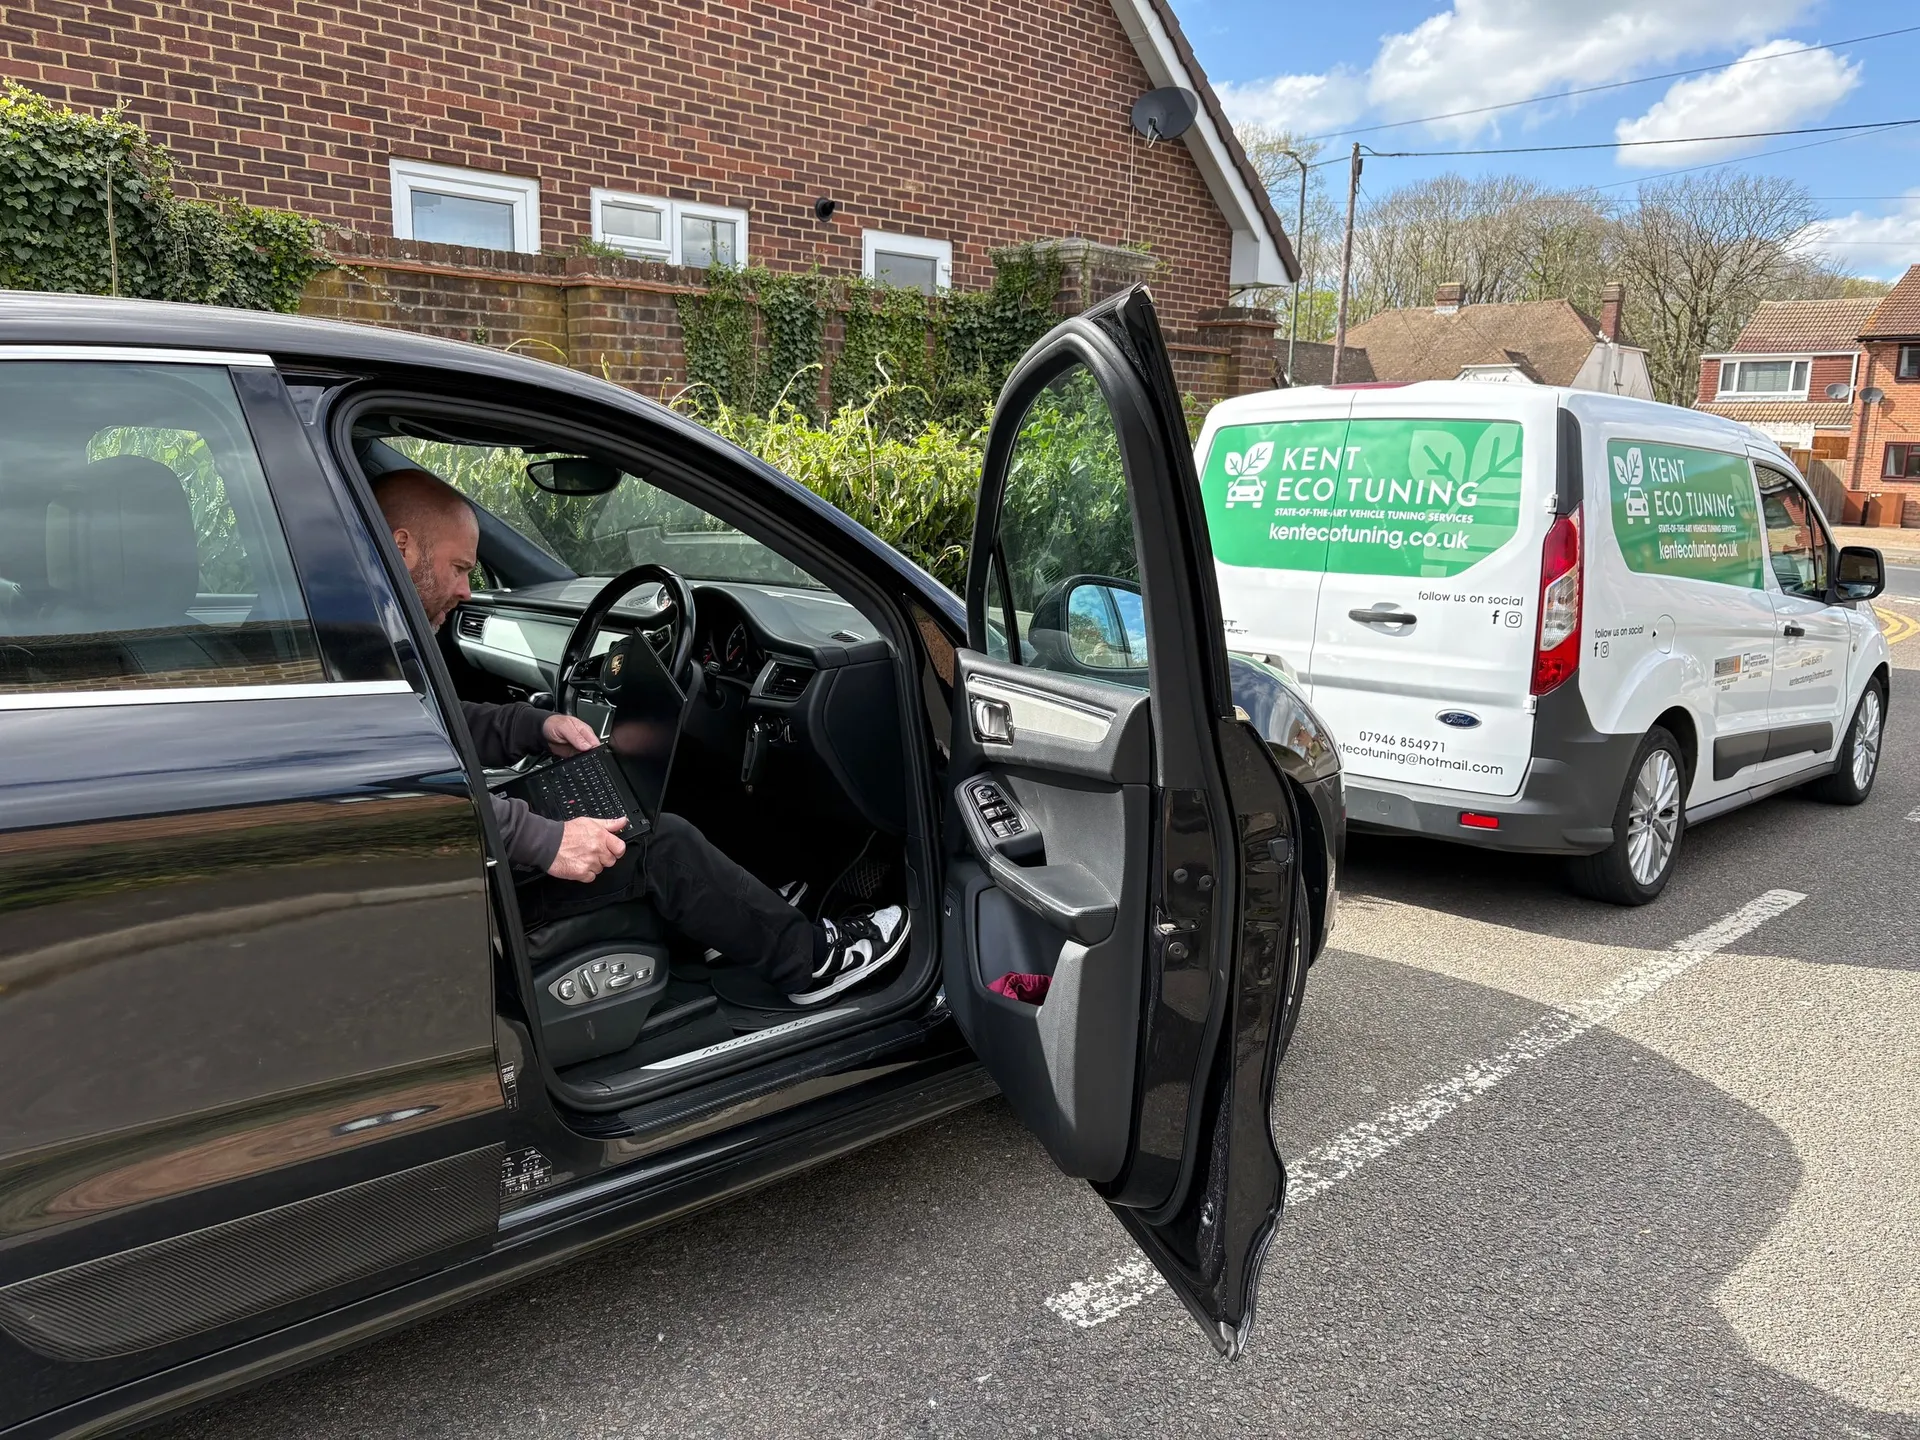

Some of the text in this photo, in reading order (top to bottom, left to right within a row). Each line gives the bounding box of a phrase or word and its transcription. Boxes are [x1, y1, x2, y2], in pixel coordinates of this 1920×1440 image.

[1281, 446, 1362, 471] KENT
[1648, 456, 1687, 484] KENT
[1276, 477, 1480, 507] ECO TUNING
[1653, 490, 1736, 518] ECO TUNING
[1274, 507, 1474, 524] STATE-OF-THE-ART VEHICLE TUNING SERVICES
[1268, 522, 1471, 550] kentecotuning.co.uk
[1658, 540, 1739, 562] kentecotuning.co.uk
[1418, 590, 1524, 607] follow us on social
[1594, 624, 1645, 639] follow us on social
[1446, 713, 1471, 726] Ford
[1359, 730, 1446, 753] 07946 854971
[1337, 742, 1504, 776] tecotuning@hotmail.com
